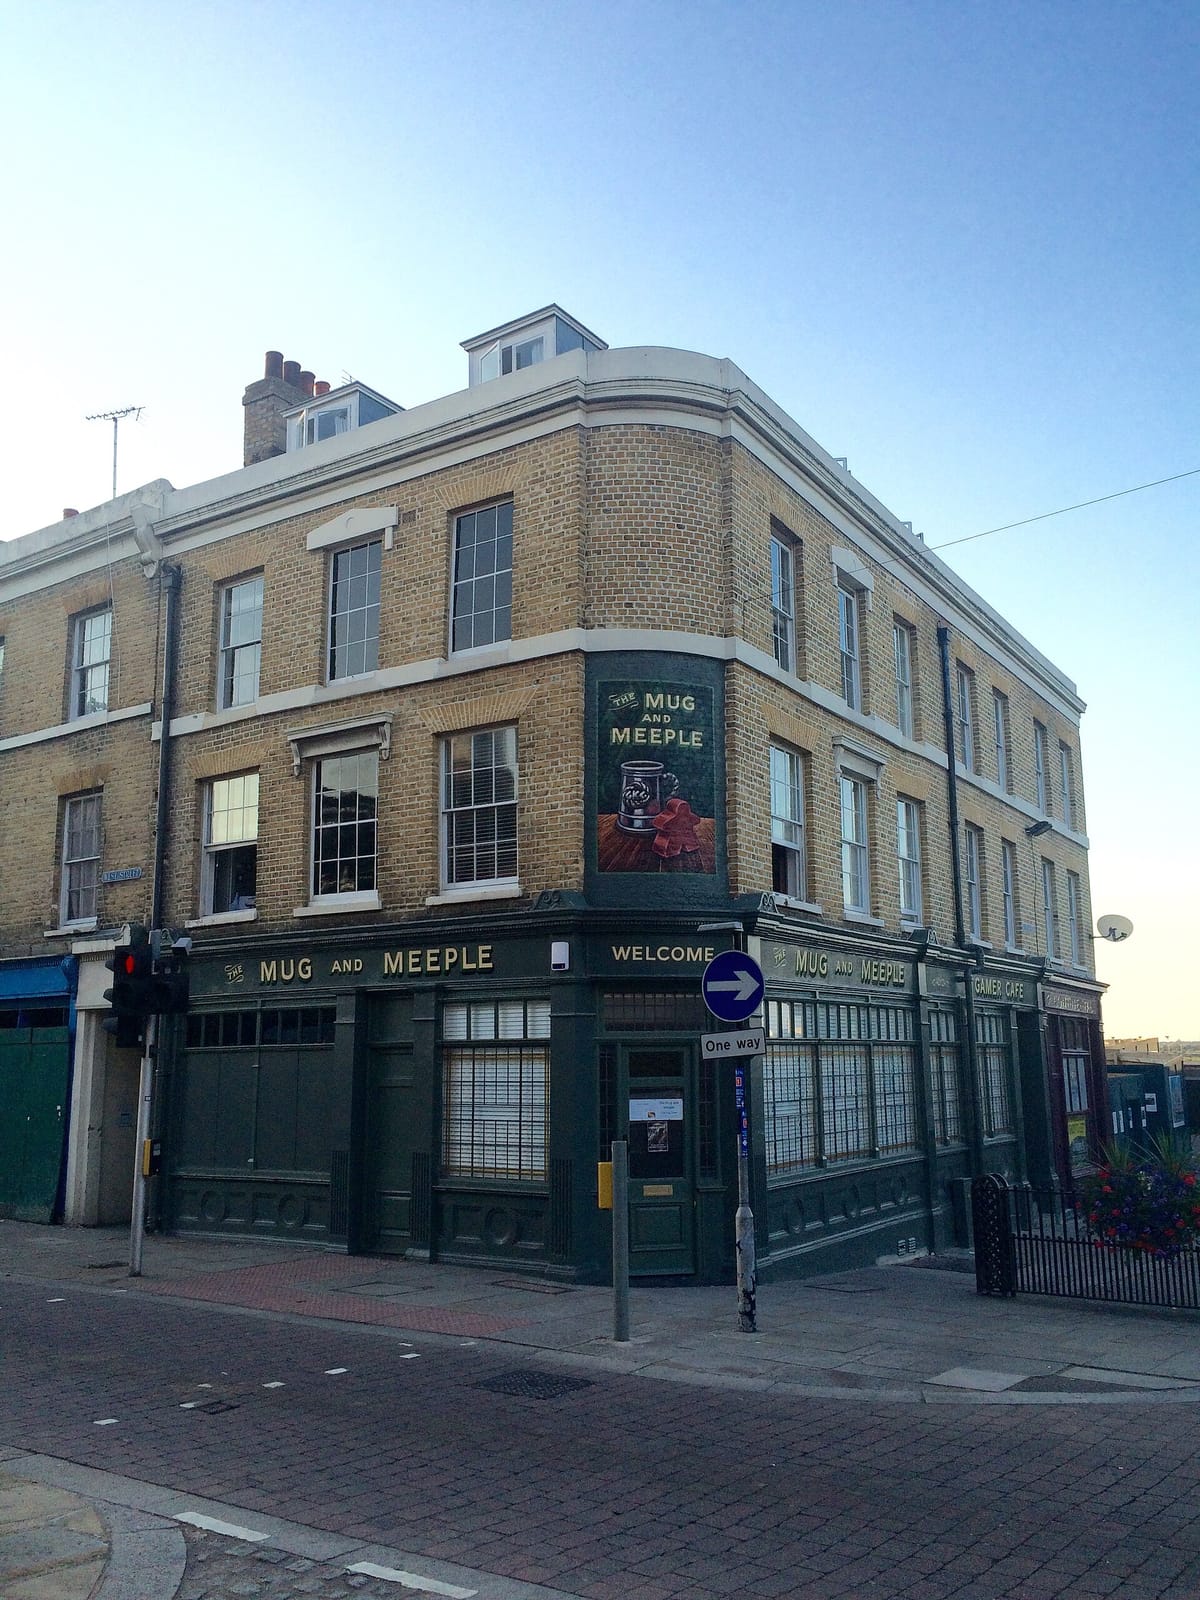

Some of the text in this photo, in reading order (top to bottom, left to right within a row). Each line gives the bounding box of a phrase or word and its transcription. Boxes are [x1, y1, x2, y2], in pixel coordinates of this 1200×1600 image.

[612, 692, 696, 711] THE MUG
[641, 713, 671, 723] AND
[610, 727, 703, 747] MEEPLE
[226, 945, 494, 982] THE MUG AND MEEPLE
[612, 946, 714, 962] WELCOME
[774, 949, 905, 985] THE MUG AND MEEPLE
[974, 976, 1024, 999] GAMER CAFE
[706, 1037, 761, 1052] One way
